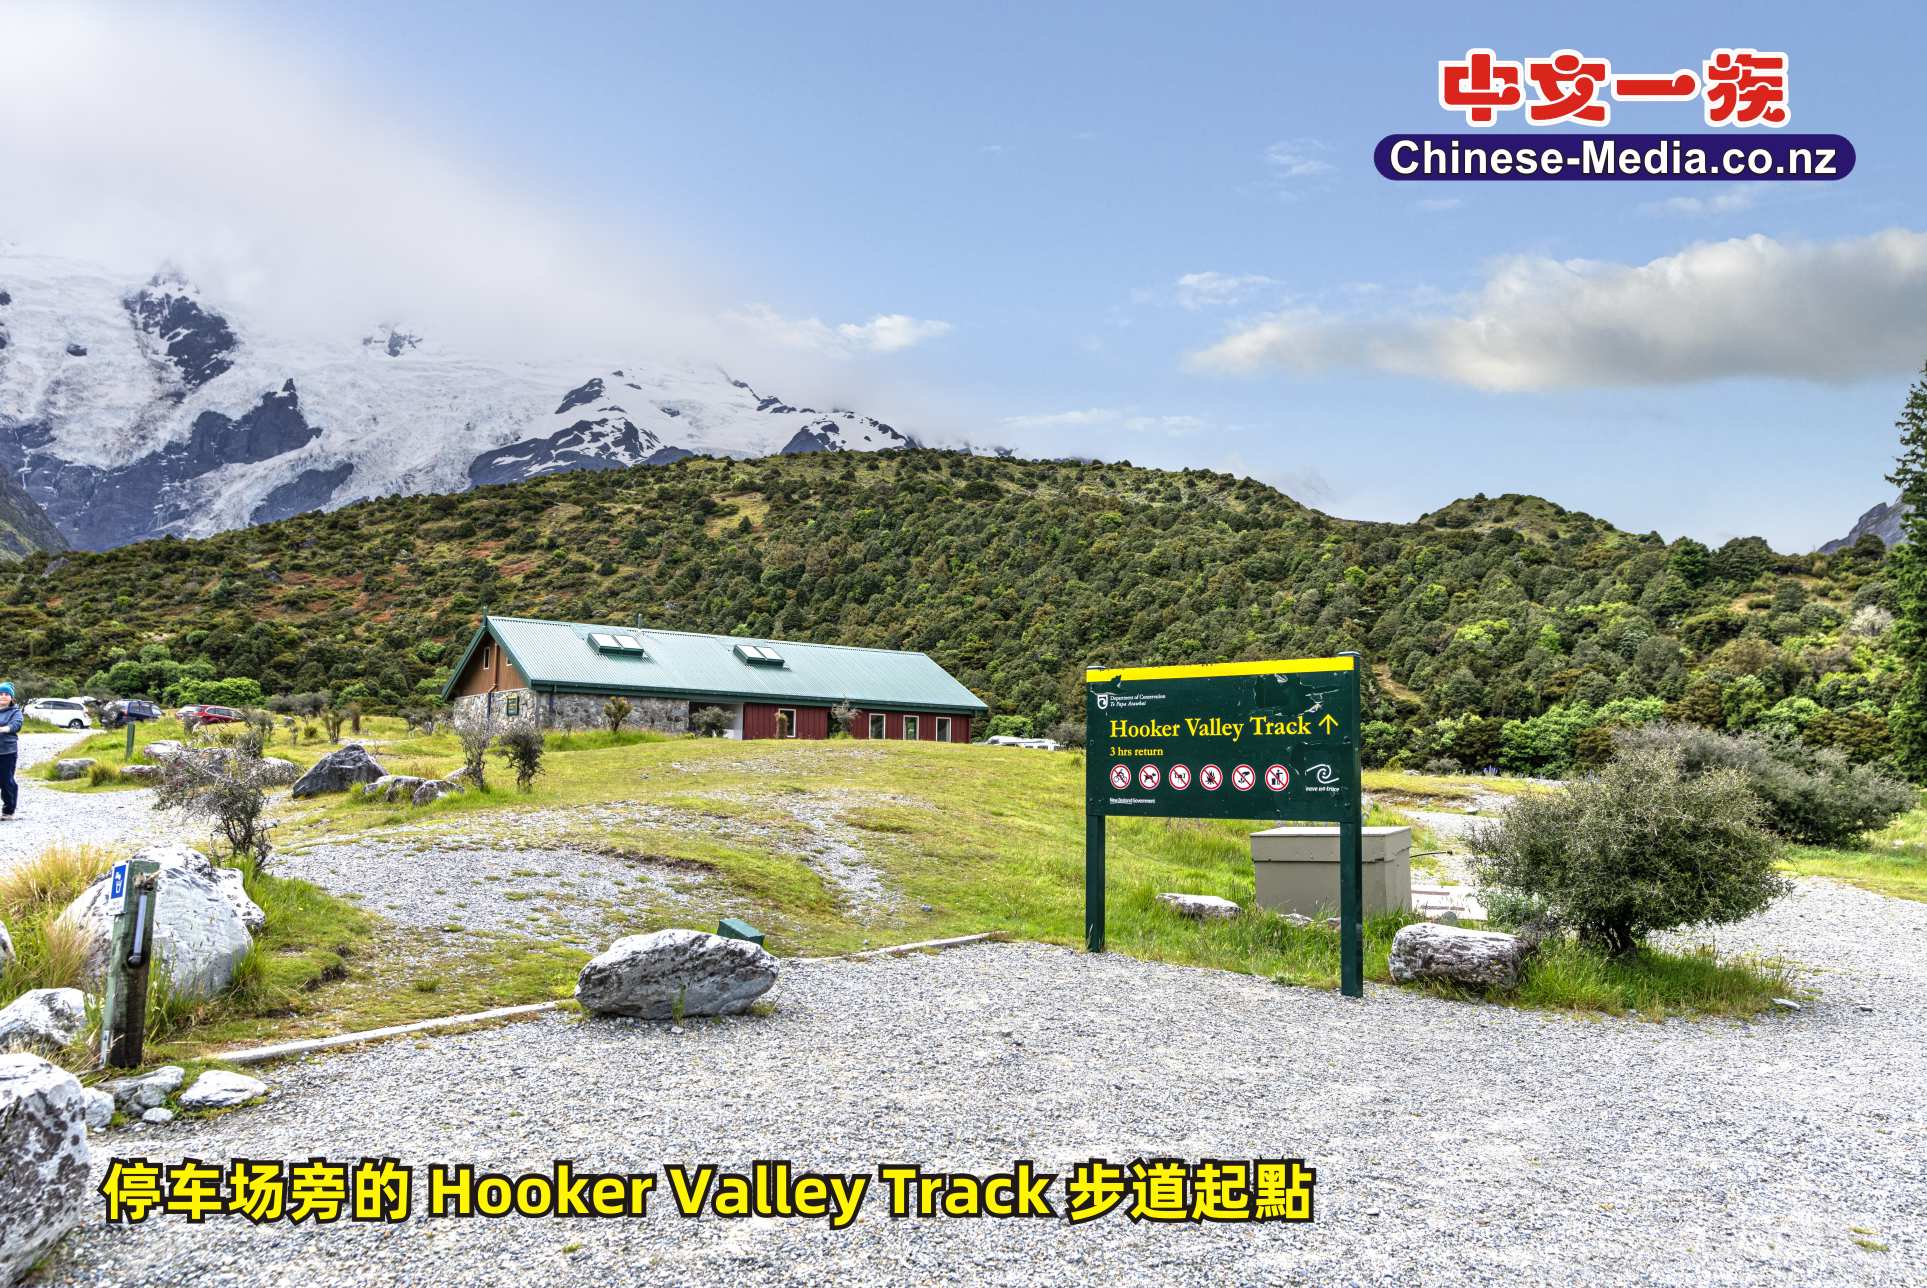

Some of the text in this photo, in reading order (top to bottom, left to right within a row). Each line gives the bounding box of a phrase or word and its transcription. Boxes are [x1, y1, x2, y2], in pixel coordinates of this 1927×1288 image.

[1110, 714, 1312, 742] Hooker Valley Track
[1110, 747, 1164, 757] 3 hrs return
